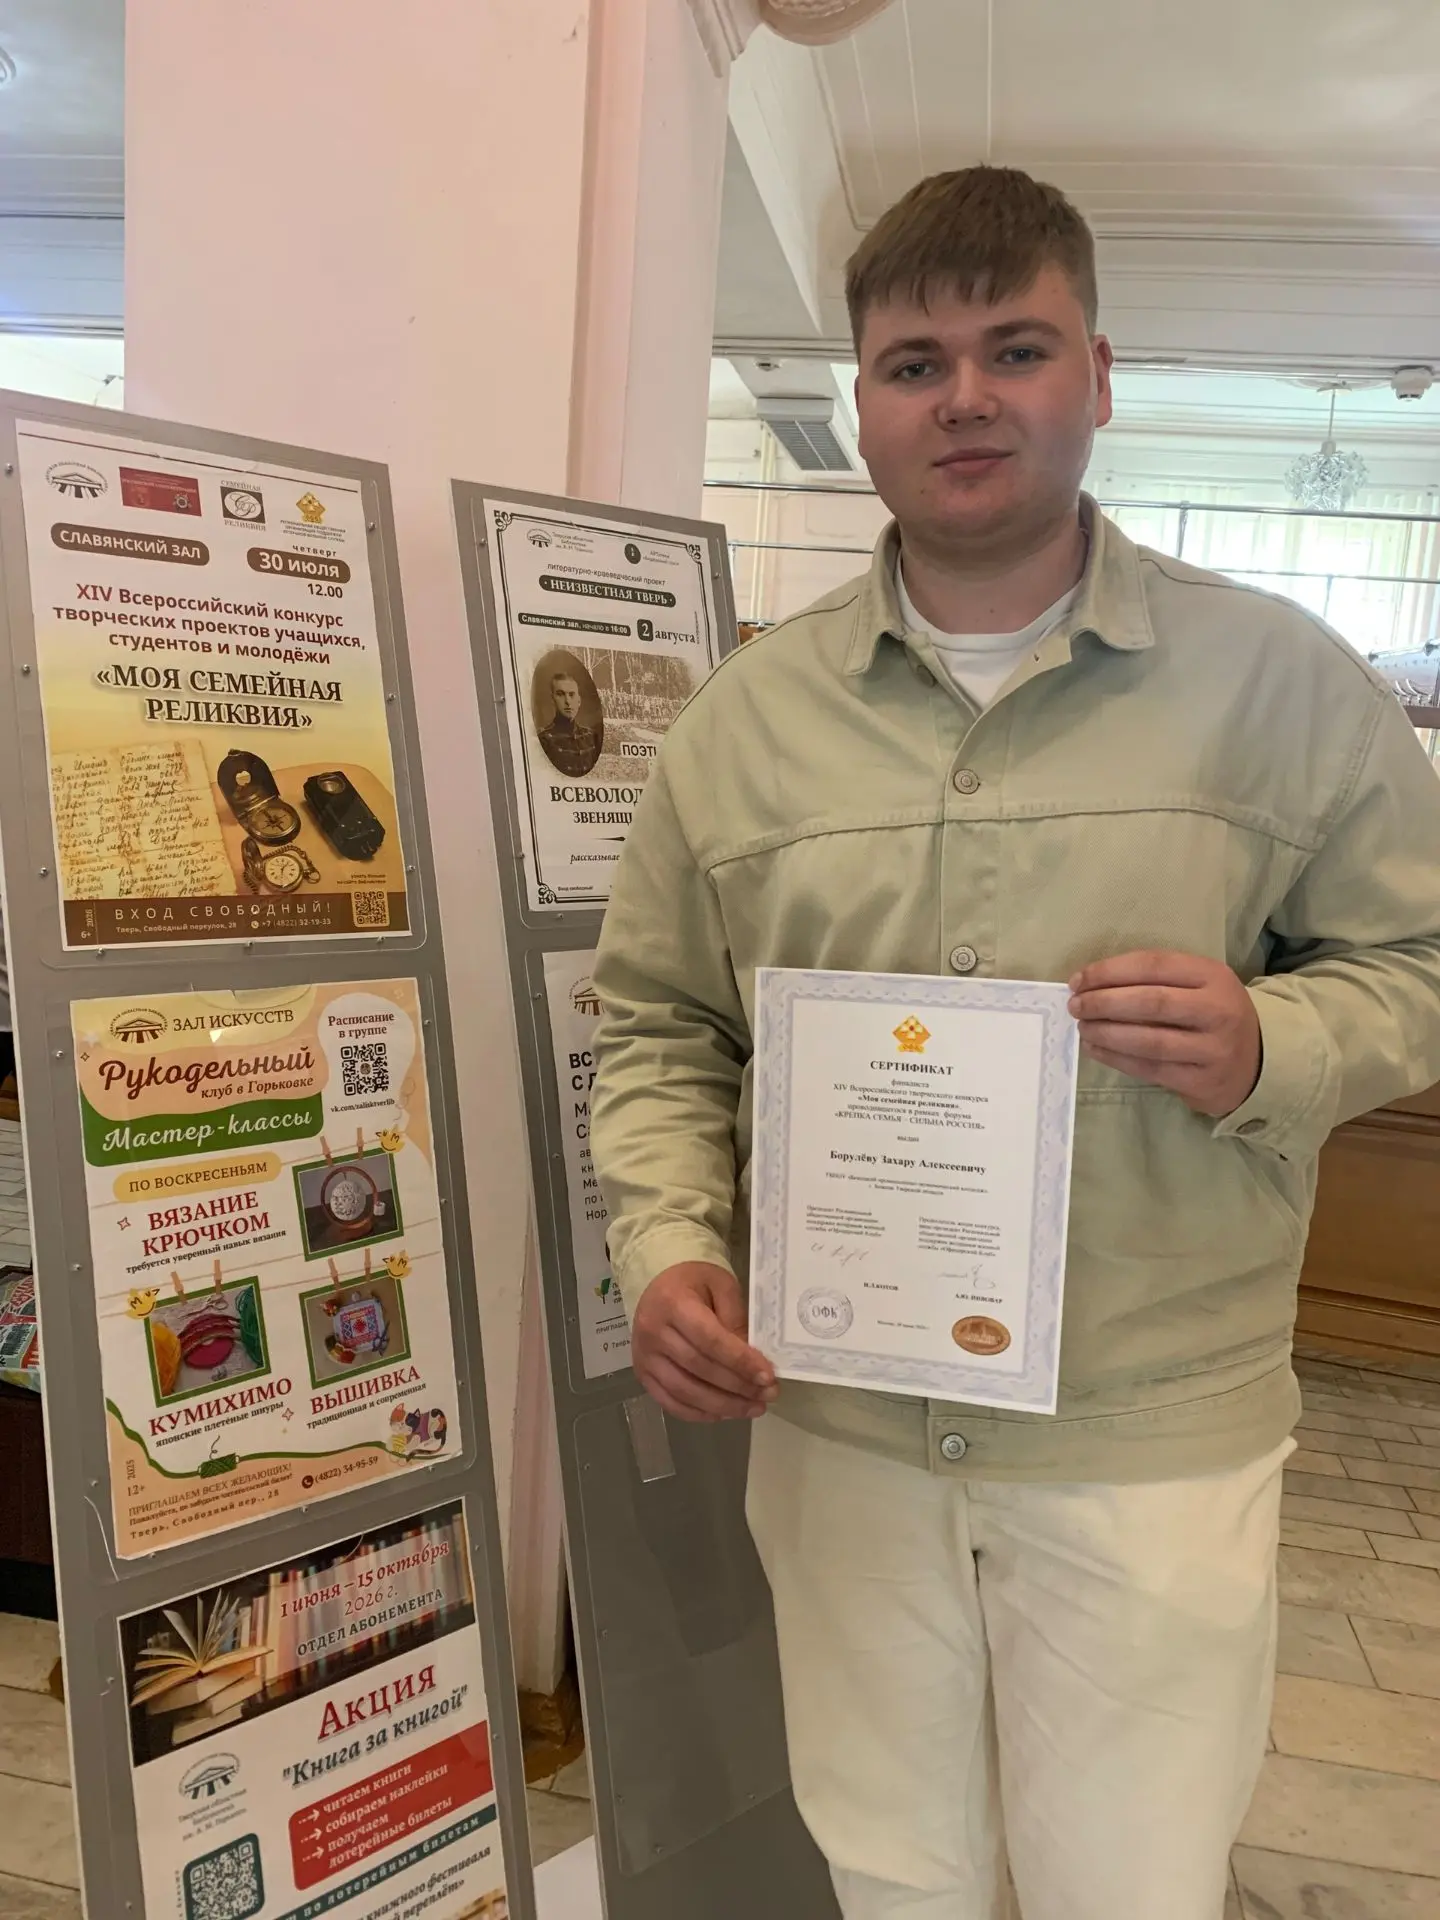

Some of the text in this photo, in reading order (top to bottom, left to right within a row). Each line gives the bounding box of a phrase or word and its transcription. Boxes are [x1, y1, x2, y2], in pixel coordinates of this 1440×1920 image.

[60, 530, 201, 559] СЛАВЯНСКИЙ ЗАЛ
[292, 544, 337, 557] четверг
[259, 552, 283, 571] 30
[307, 582, 343, 599] 12.00
[550, 580, 668, 605] НЕИЗВЕСТНАЯ ТВЕРЬ
[643, 577, 666, 586] проект
[76, 583, 344, 628] XIV Всероссийский конкурс
[53, 606, 366, 651] творческих проектов учащихся,
[521, 615, 566, 627] Славянский
[641, 623, 695, 645] 2 августа
[109, 632, 330, 665] студентов и молодёжи
[96, 665, 343, 701] «МОЯ СЕМЕЙНАЯ
[146, 699, 313, 728] РЕЛИКВИЯ»
[570, 853, 621, 864] рассказывае
[115, 901, 332, 921] ВХОД СВОБОДНЫЙ!
[81, 930, 92, 939] 6+
[116, 926, 142, 934] Тверь,
[144, 923, 188, 932] Свободный
[189, 923, 226, 932] переулок,
[173, 1009, 295, 1031] ЗАЛ ИСКУССТВ
[328, 1012, 395, 1027] Расписание
[338, 1026, 388, 1040] в группе
[98, 1047, 315, 1100] Рукодельный
[569, 1051, 593, 1069] ВС
[870, 1061, 954, 1075] СЕРТИФИКАТ
[201, 1077, 314, 1100] клуб в Горьковке
[102, 1109, 313, 1152] Мастер-классы
[579, 1149, 591, 1159] ав
[829, 1150, 987, 1175] Борулёву Захару Алексеевичу
[129, 1161, 268, 1193] ПО ВОСКРЕСЕНЬЯМ
[581, 1165, 594, 1174] кн
[583, 1178, 598, 1189] Ме
[148, 1191, 259, 1231] ВЯЗАНИЕ
[586, 1209, 608, 1221] Нор
[142, 1211, 271, 1258] КРЮЧКОМ
[126, 1229, 287, 1275] требуется уверенный навык вязания
[310, 1364, 421, 1415] ВЫШИВКА
[149, 1377, 293, 1437] КУМИХИМО
[306, 1381, 428, 1430] традиционная и современная
[155, 1399, 285, 1448] японские плетёные шнуры
[126, 1459, 136, 1481] 2025
[314, 1456, 379, 1485] (4822) 34-95-59
[127, 1484, 146, 1498] 12+
[128, 1462, 293, 1517] ПРИГЛАШАЕМ ВСЕХ ЖЕЛАЮЩИХ!
[130, 1525, 170, 1539] Тверь,
[172, 1501, 236, 1527] Свободный
[268, 1489, 280, 1499] 28
[280, 1602, 288, 1618] 1
[292, 1584, 341, 1611] июня
[357, 1570, 374, 1589] 15
[377, 1541, 450, 1580] октября
[344, 1587, 399, 1617] 2026 г.
[297, 1588, 444, 1657] ОТДЕЛ АБОНЕМЕНТА
[283, 1742, 362, 1788] "Книга
[366, 1727, 389, 1749] за
[394, 1684, 469, 1738] книгой"
[323, 1764, 412, 1814] читаем книги
[325, 1764, 449, 1833] собираем наклейки
[328, 1814, 389, 1854] получаем
[329, 1796, 453, 1870] лотерейные билеты
[328, 1851, 418, 1906] лотерейным
[423, 1816, 480, 1852] билетам
[427, 1846, 491, 1893] фестиваля
